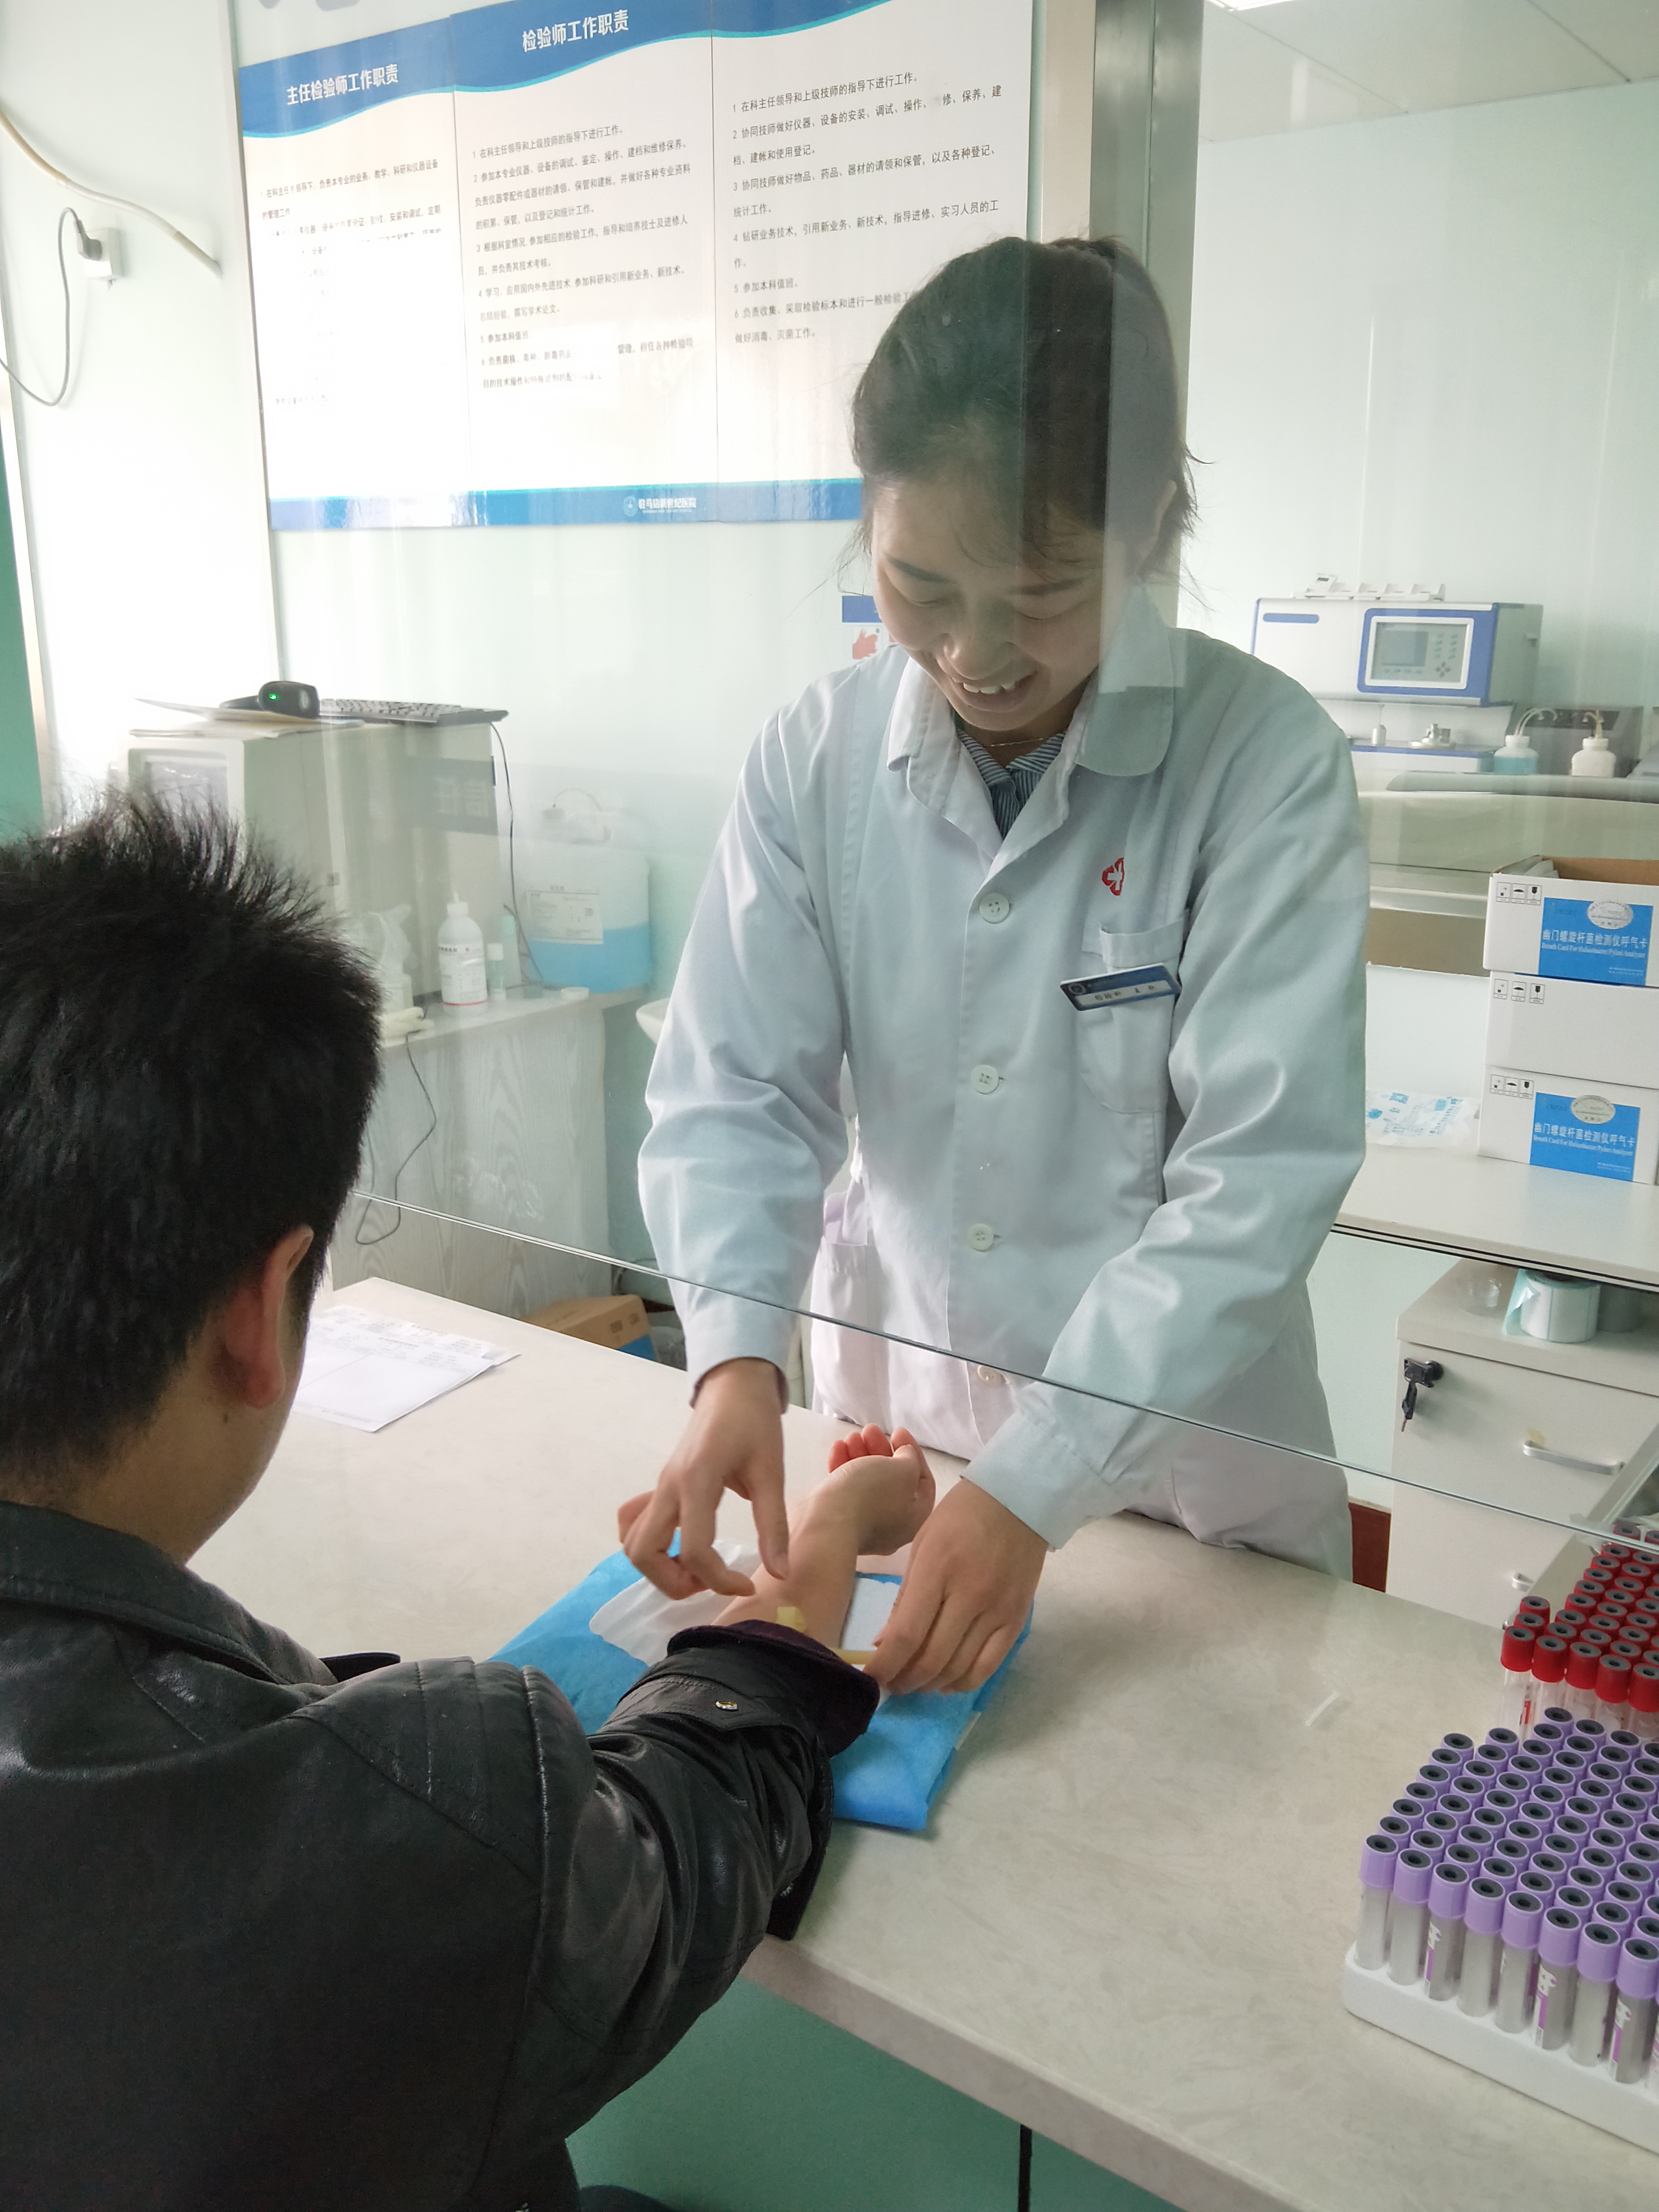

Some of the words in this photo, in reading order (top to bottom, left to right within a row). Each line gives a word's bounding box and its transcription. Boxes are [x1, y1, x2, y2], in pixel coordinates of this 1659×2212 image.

[522, 9, 629, 53] 检验师工作职责
[287, 63, 399, 106] 主任检验师工作职责
[733, 104, 736, 113] 1
[741, 71, 917, 113] 在科主任领导和上级技师的指导下进行工作。
[733, 130, 737, 139] 2
[741, 84, 1002, 139] 协同技师做好仪器、设备的安装、调试、操作、修、保养、建
[733, 182, 738, 192] 3
[733, 203, 771, 218] 统计工作。
[733, 233, 738, 242] 4
[733, 284, 739, 293] 5
[734, 309, 739, 319] 6
